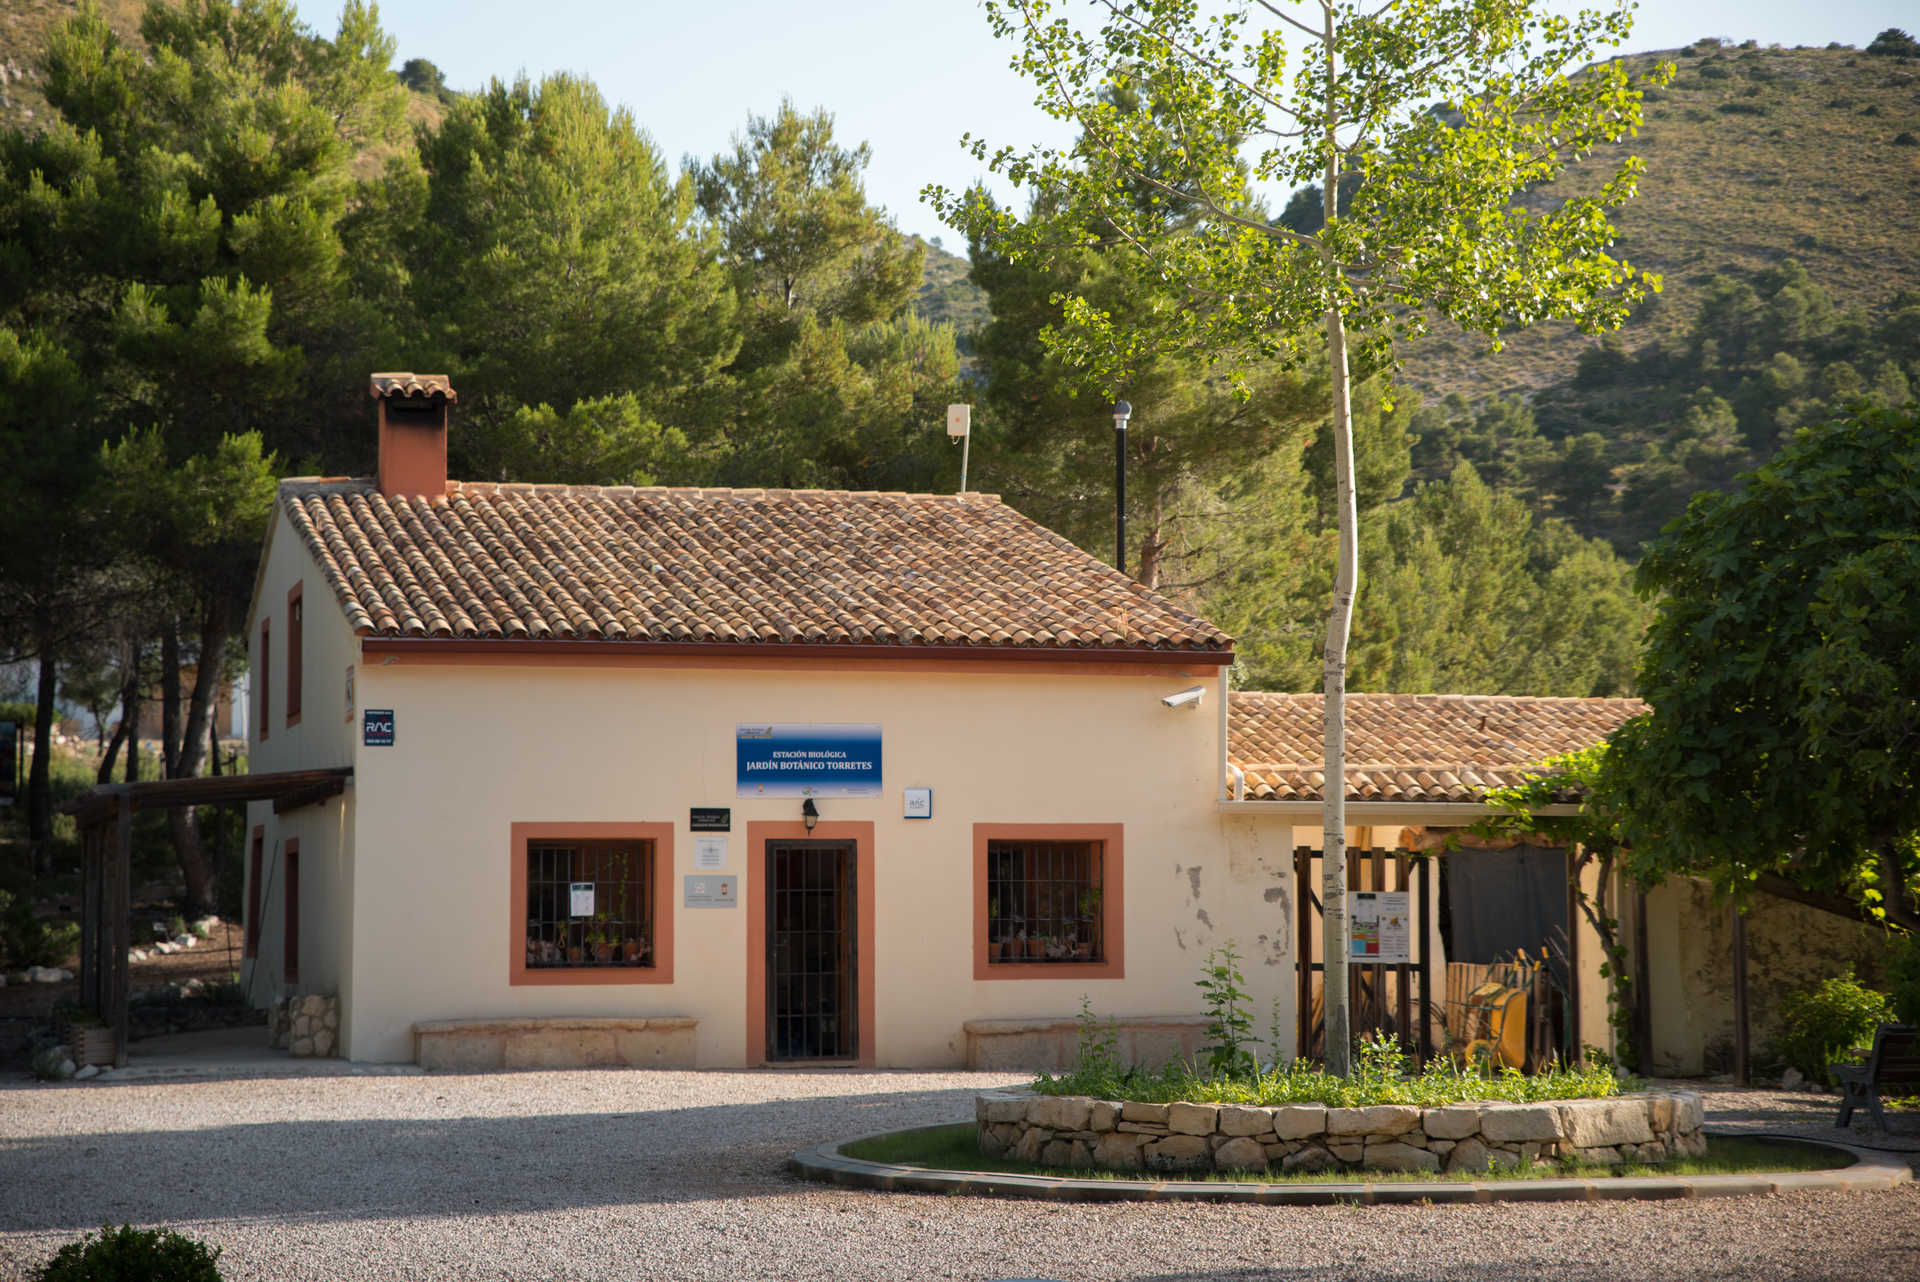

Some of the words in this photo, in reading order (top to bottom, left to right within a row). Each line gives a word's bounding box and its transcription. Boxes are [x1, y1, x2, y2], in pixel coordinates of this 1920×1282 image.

[772, 750, 807, 758] ESTACIÓN
[808, 750, 847, 758] BIOLÓGICA
[746, 760, 778, 771] JARDÍN
[780, 760, 825, 770] BOTÁNICO
[827, 761, 873, 770] TORRETES
